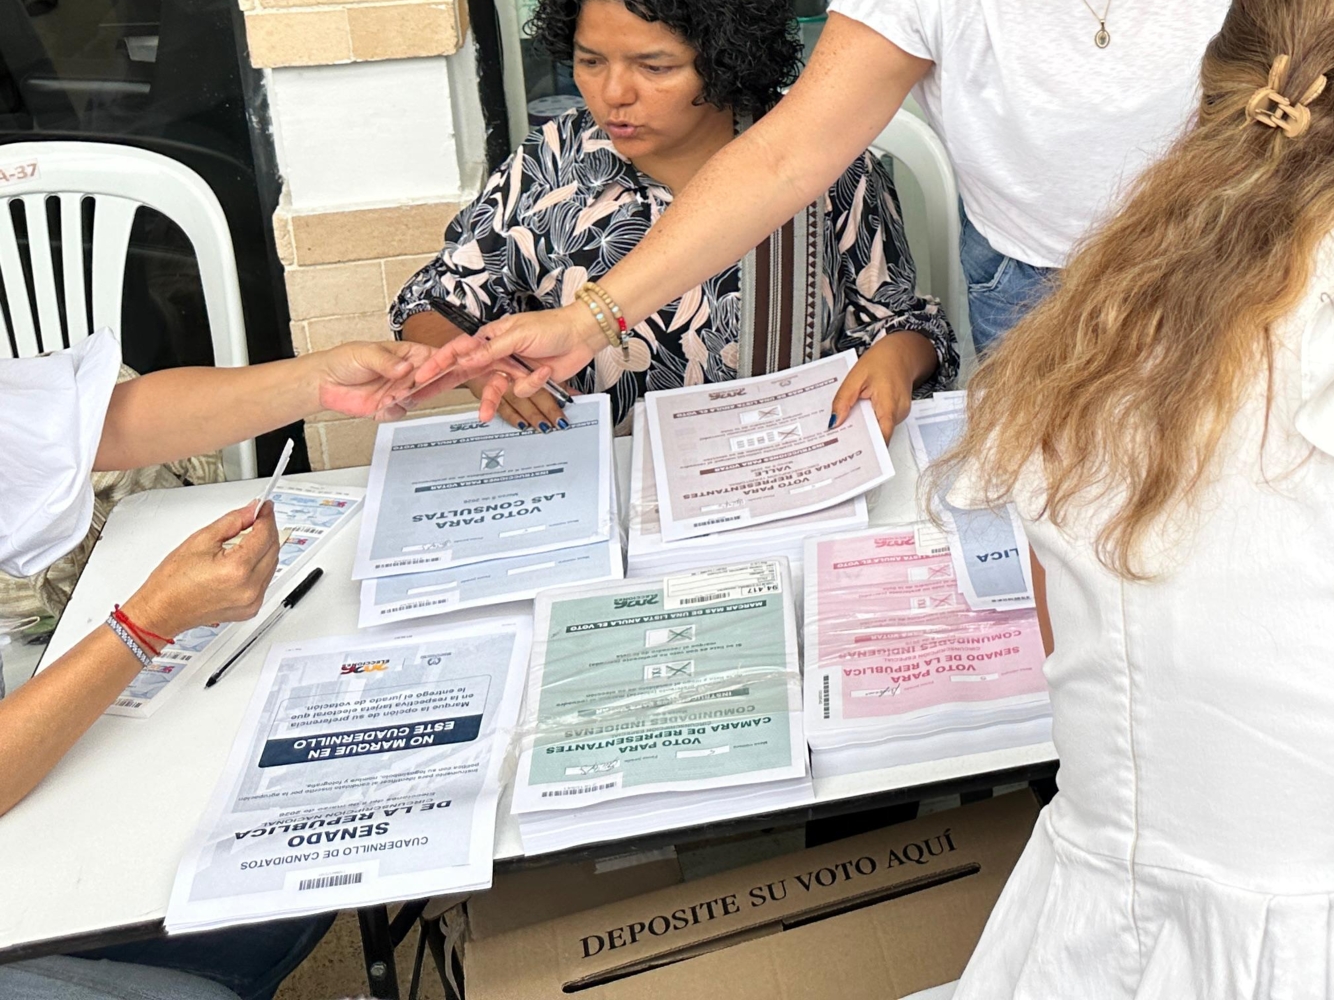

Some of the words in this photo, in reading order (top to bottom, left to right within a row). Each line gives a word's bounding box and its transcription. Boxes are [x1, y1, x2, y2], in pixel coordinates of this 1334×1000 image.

[754, 465, 792, 478] VALLE
[796, 469, 812, 478] DE
[430, 483, 458, 491] VOTAR
[682, 475, 793, 500] REPRESENTANTES
[778, 477, 810, 489] VOTO
[743, 485, 774, 496] PARA
[531, 492, 566, 504] LAS
[411, 499, 525, 523] CONSULTAS
[492, 506, 542, 521] VOTO
[435, 516, 485, 529] PARA
[874, 536, 915, 548] 2026
[614, 597, 659, 609] 2026
[726, 601, 763, 611] MARCAR
[642, 614, 668, 622] LISTA
[670, 611, 689, 619] UNA
[570, 624, 595, 632] VOTO
[610, 618, 641, 626] ANULA
[920, 629, 1022, 650] COMUNIDADES
[945, 654, 962, 664] DE
[966, 646, 1020, 662] SENADO
[342, 659, 390, 668] ELECCIONES
[923, 656, 941, 667] LA
[340, 663, 388, 676] 2026
[843, 661, 920, 677] REPÚBLICA
[936, 663, 976, 674] VOTO
[890, 669, 931, 684] PARA
[353, 699, 367, 707] de
[370, 694, 403, 705] jurado
[395, 696, 448, 709] respectiva
[304, 701, 351, 711] votación.
[360, 702, 393, 713] tarjeta
[432, 701, 471, 711] Marque
[290, 711, 311, 721] que
[313, 708, 358, 719] electoral
[383, 707, 419, 718] opción
[650, 704, 756, 726] COMUNIDADES
[290, 715, 350, 728] preferencia
[414, 720, 455, 734] ESTE
[711, 717, 772, 733] CÁMARA
[688, 727, 706, 736] DE
[293, 726, 411, 750] CUADERNILLO
[411, 734, 435, 746] NO
[546, 729, 682, 754] REPRESENTANTES
[661, 737, 701, 747] VOTO
[335, 737, 407, 758] MARQUE
[618, 742, 657, 754] PARA
[308, 749, 332, 760] EN
[383, 805, 413, 817] LA
[420, 800, 452, 812] DE
[234, 811, 374, 841] REPÚBLICA
[261, 814, 323, 828] NACIONAL
[287, 821, 390, 848] SENADO
[343, 836, 429, 856] CUADERNILLO
[323, 848, 340, 859] DE
[240, 851, 319, 871] CANDIDATOS
[579, 893, 740, 959] DEPOSITE
[748, 879, 788, 908] SU
[795, 856, 878, 893] VOTO
[887, 828, 958, 869] AQUÍ
